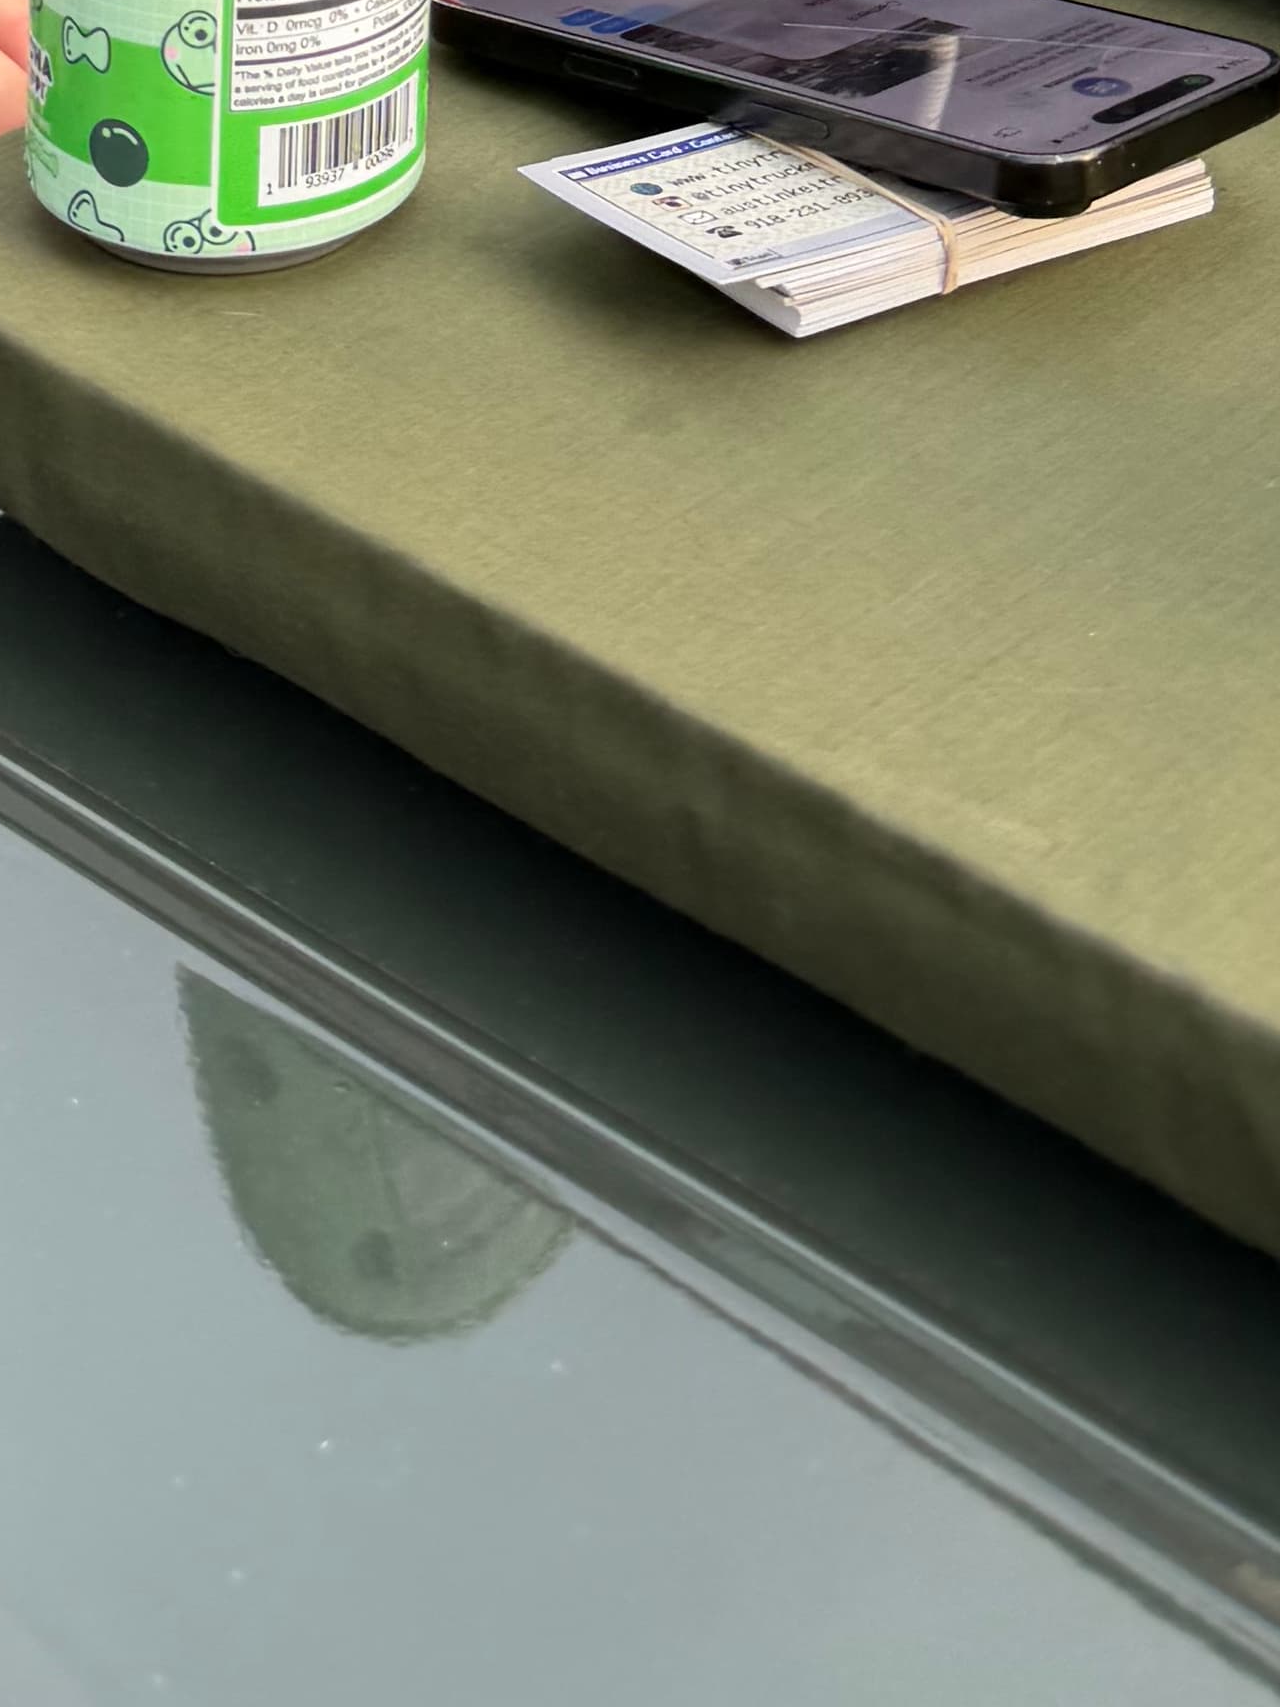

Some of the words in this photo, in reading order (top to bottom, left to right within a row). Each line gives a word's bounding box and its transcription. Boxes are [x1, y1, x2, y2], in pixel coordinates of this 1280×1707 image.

[267, 20, 278, 34] D
[328, 10, 349, 24] 0%
[235, 40, 262, 56] Iron
[266, 39, 296, 56] 0mg
[300, 36, 321, 50] 0%
[277, 66, 302, 79] Daily
[285, 78, 296, 90] of
[298, 74, 320, 87] food
[234, 96, 275, 107] calories
[287, 90, 307, 102] day
[585, 155, 646, 176] Business
[647, 145, 682, 163] Card
[266, 183, 273, 195] 1
[305, 169, 345, 189] 93937
